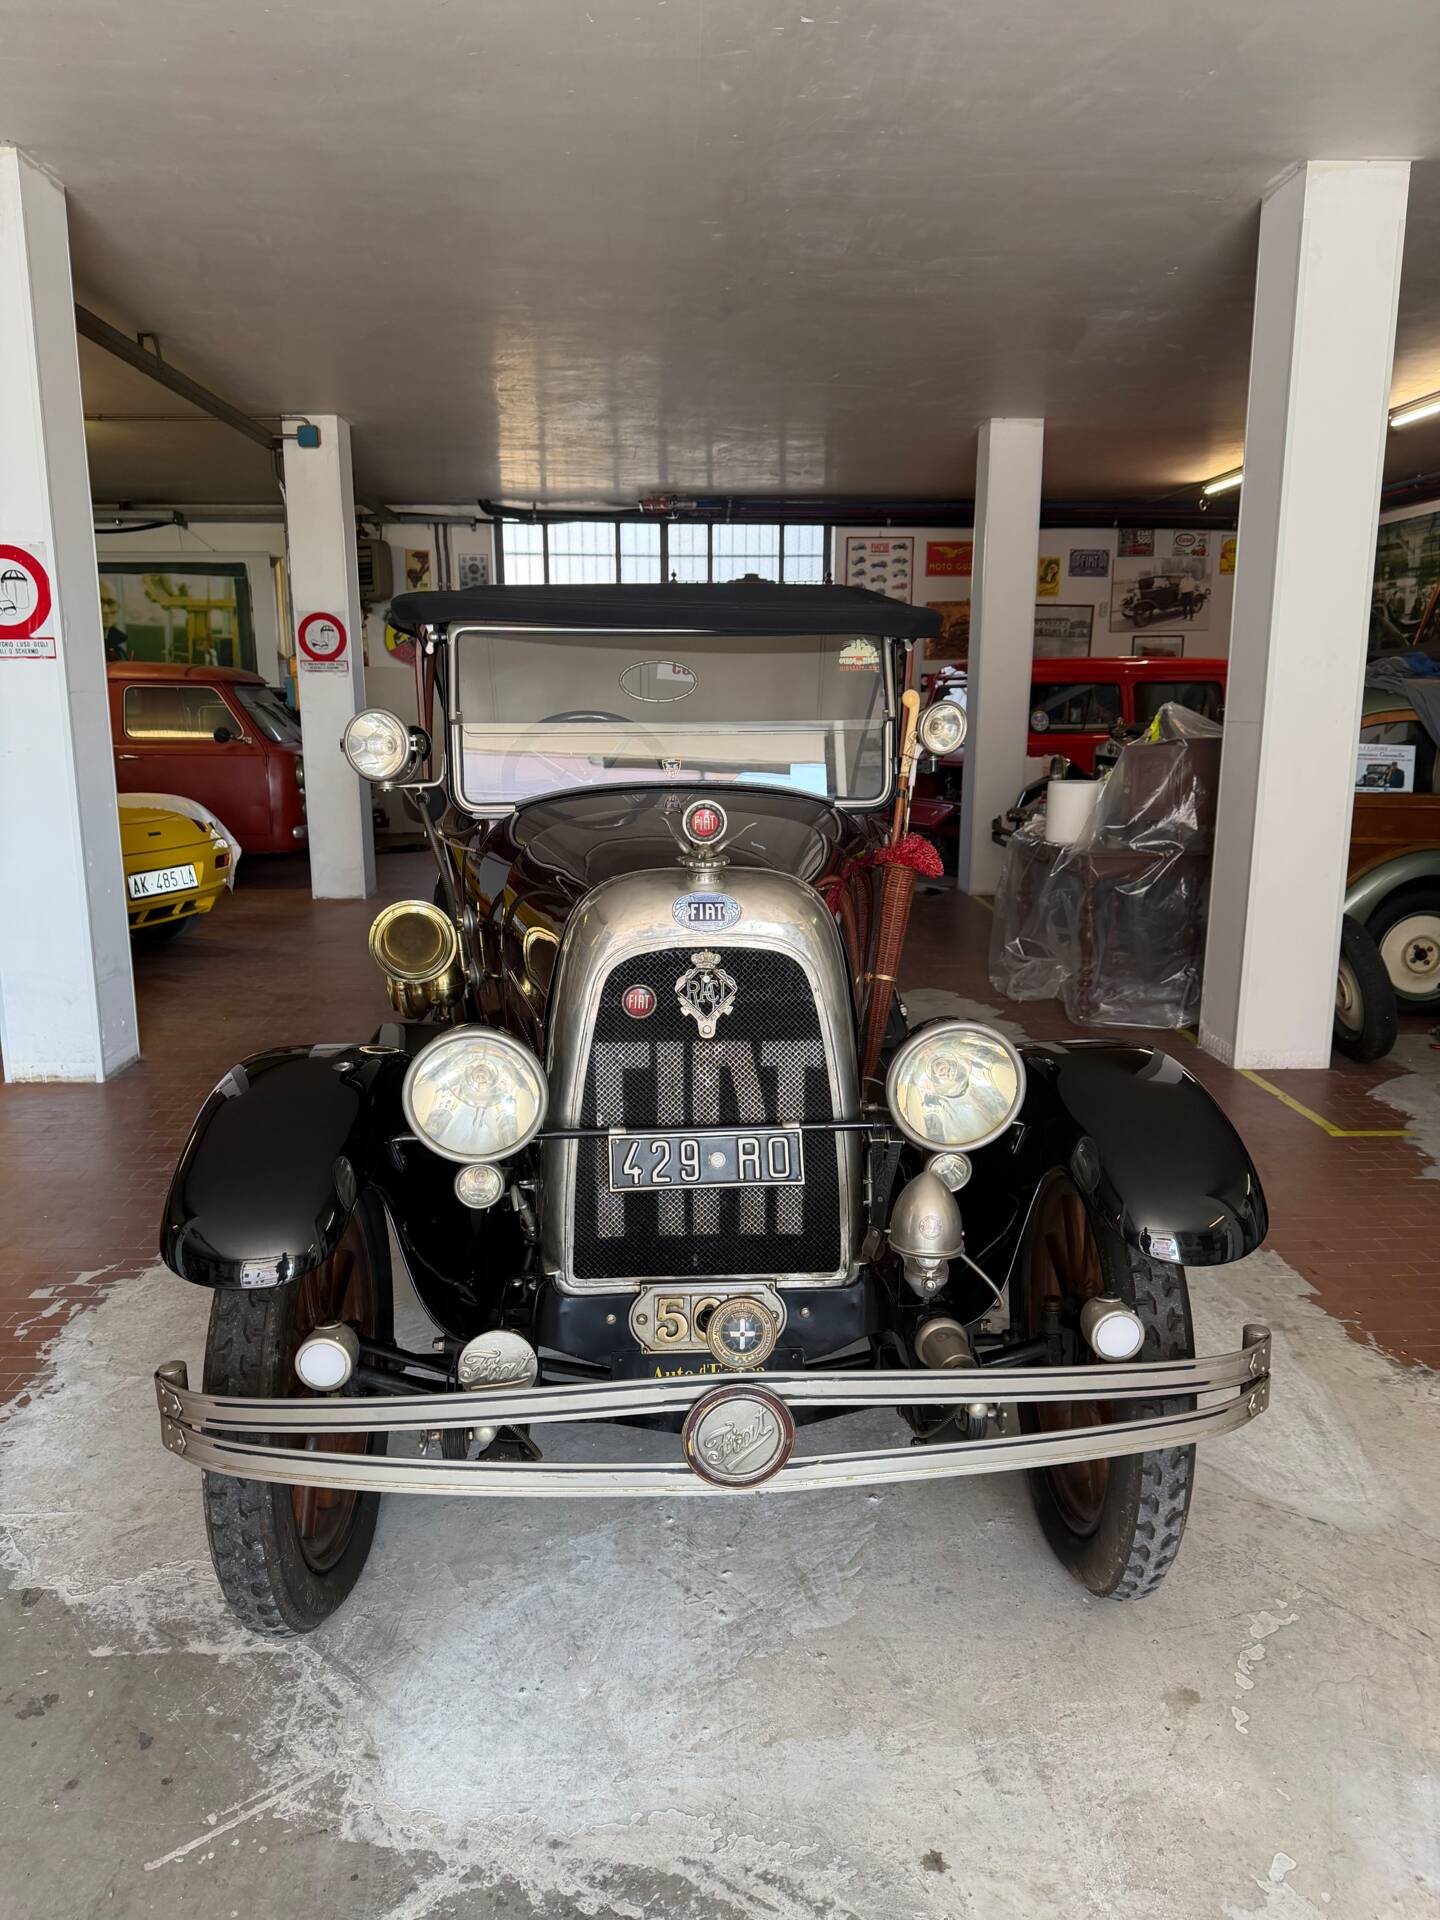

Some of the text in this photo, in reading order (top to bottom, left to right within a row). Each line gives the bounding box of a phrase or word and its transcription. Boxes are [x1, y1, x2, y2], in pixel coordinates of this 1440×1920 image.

[694, 815, 716, 831] FIAT
[133, 876, 150, 896] AK
[156, 870, 179, 891] 485
[690, 903, 724, 920] FIAT
[628, 994, 651, 1010] FIAT
[622, 1136, 792, 1185] 429 RO
[460, 1348, 536, 1384] Fiat
[703, 1405, 775, 1466] Fiat
